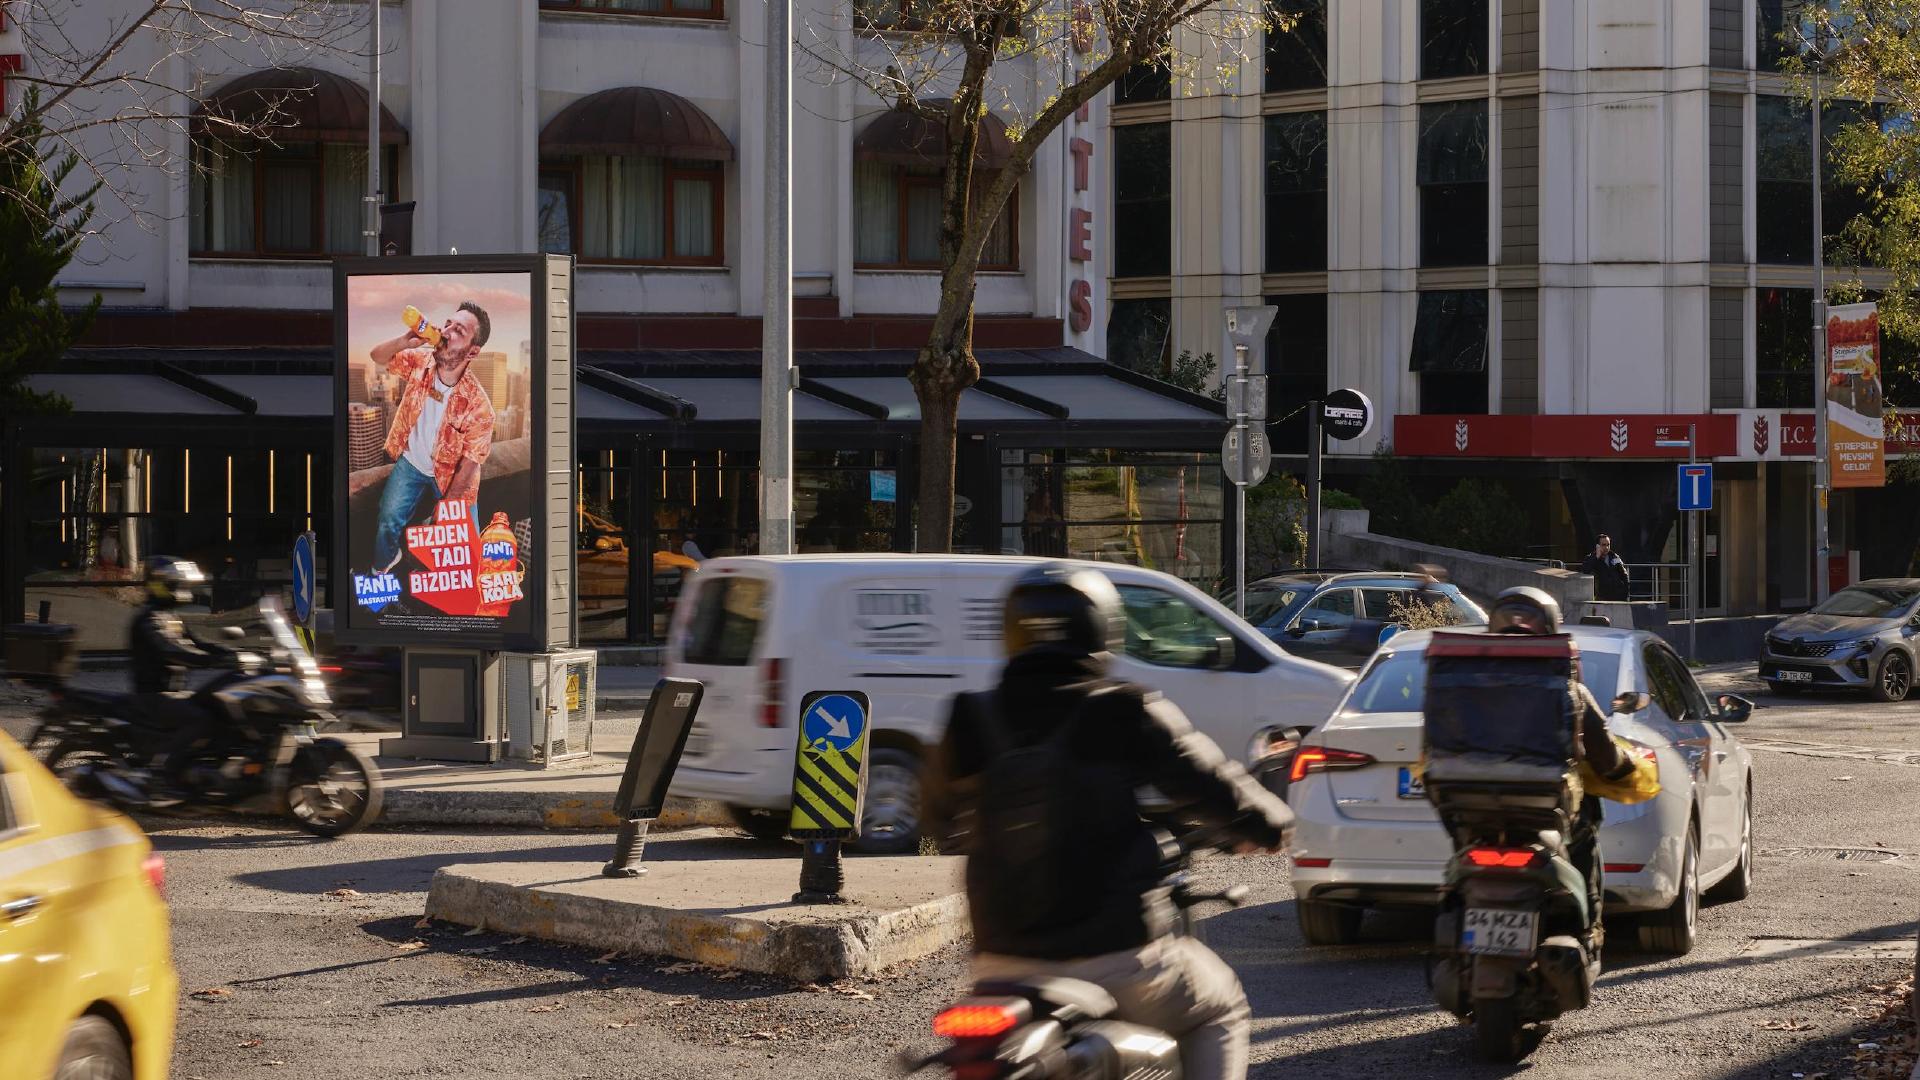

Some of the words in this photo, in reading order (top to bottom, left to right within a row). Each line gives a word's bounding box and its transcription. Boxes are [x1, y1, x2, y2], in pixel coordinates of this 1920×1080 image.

[1780, 426, 1808, 443] T.C.
[1834, 441, 1879, 451] STREPSILS
[438, 500, 467, 521] ADI
[431, 546, 471, 568] TADI
[482, 541, 514, 557] FANTA
[354, 574, 401, 595] FANTA
[480, 572, 519, 589] SARI
[483, 585, 524, 604] KOLA
